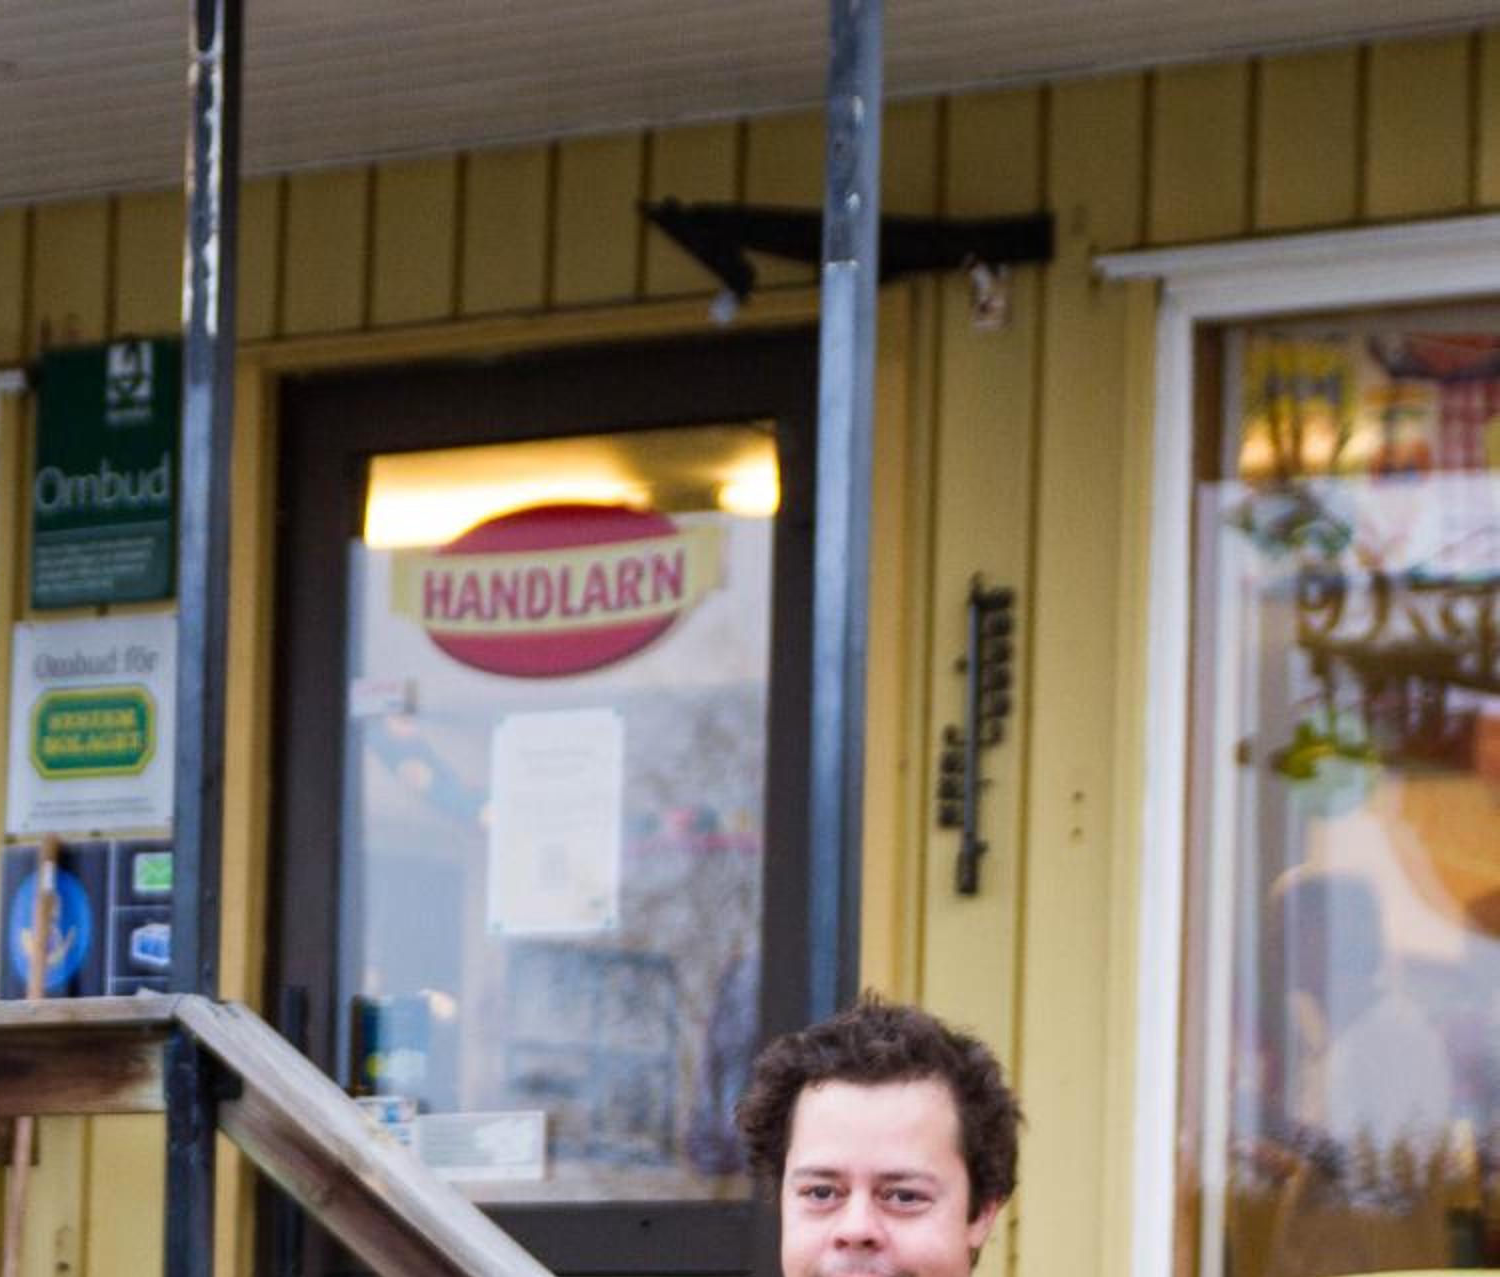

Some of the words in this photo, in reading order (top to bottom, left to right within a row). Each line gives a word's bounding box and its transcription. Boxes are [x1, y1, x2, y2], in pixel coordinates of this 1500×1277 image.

[35, 450, 170, 514] Ombud
[34, 647, 117, 678] Ombud
[124, 644, 159, 673] för
